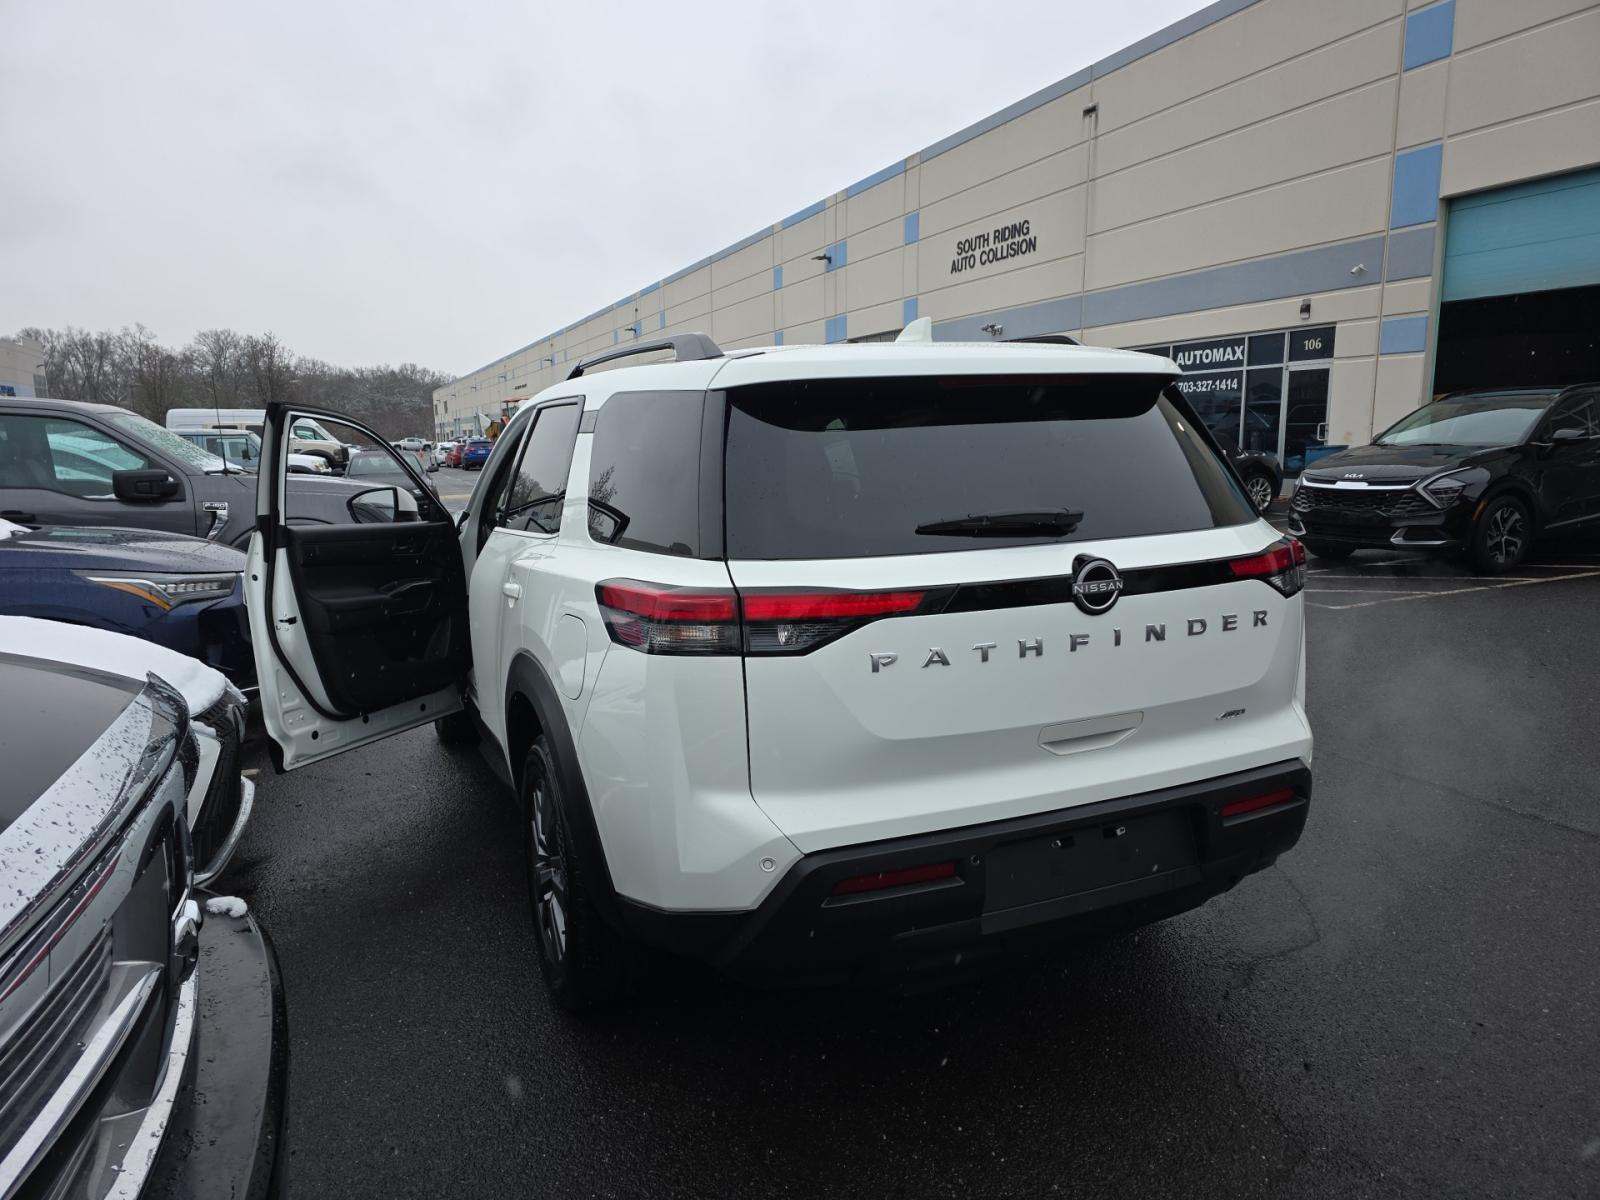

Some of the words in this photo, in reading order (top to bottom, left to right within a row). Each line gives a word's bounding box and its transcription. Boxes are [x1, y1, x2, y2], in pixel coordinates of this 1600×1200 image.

[957, 232, 990, 256] SOUTH
[993, 220, 1030, 245] RIDING
[951, 254, 976, 274] AUTO
[979, 236, 1037, 265] COLLISION
[1304, 338, 1322, 350] 106
[1176, 345, 1244, 366] AUTOMAX
[1178, 378, 1238, 393] 703-327-1414
[1074, 581, 1123, 594] NISSAN
[870, 609, 1269, 674] PATHFINDER
